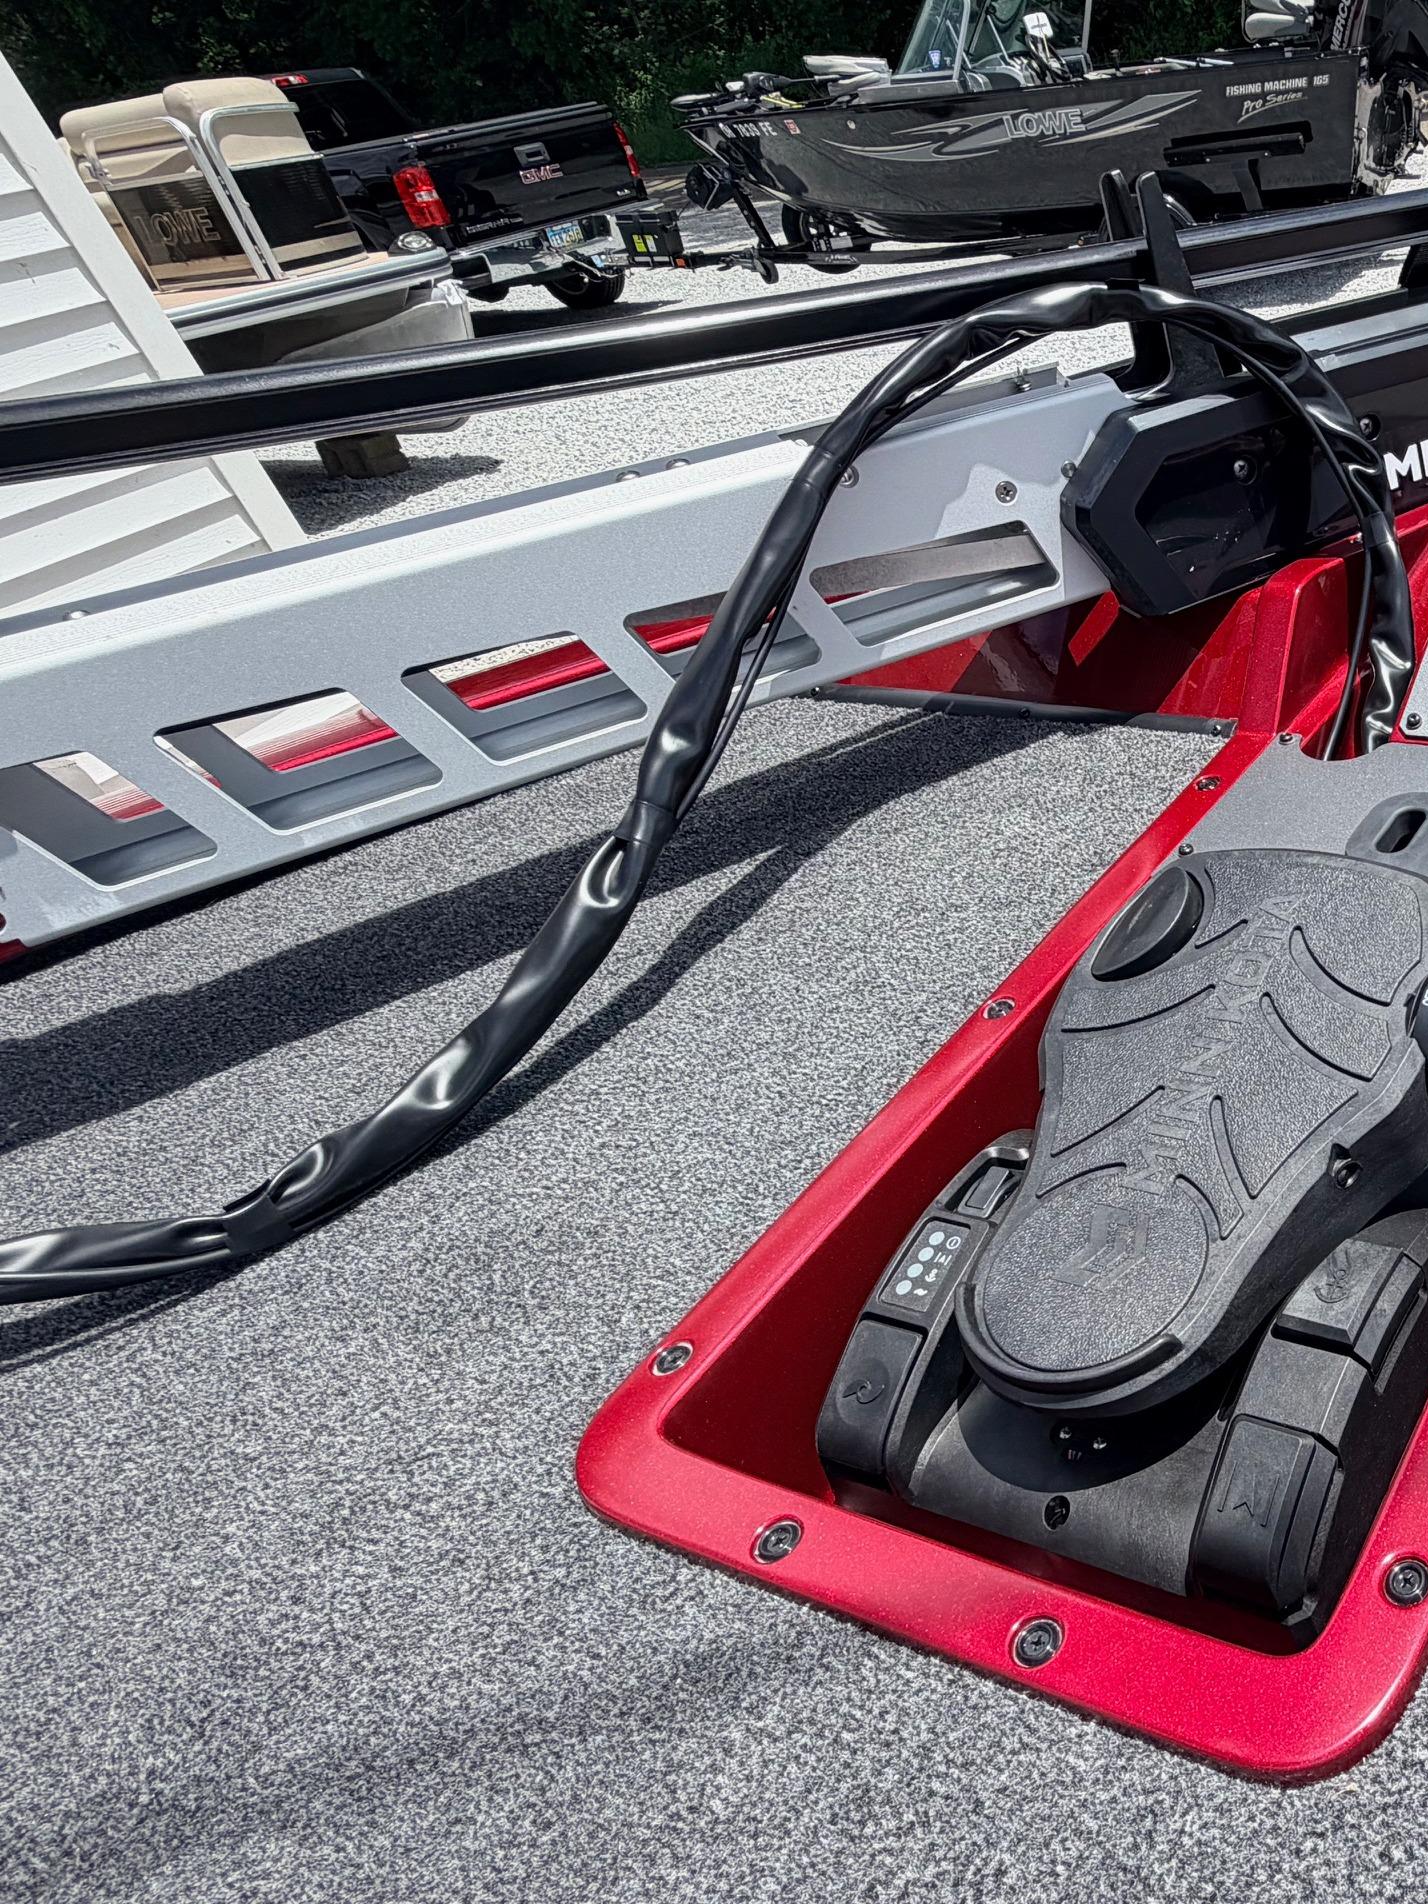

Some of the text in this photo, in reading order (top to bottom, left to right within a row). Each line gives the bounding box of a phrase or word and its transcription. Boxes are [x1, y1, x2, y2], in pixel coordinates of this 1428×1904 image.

[1226, 83, 1262, 97] FISHING
[1264, 77, 1308, 92] MACHINE
[1242, 92, 1304, 116] Pro Series
[1002, 108, 1087, 139] LOWE
[519, 163, 564, 185] GMC
[133, 206, 221, 247] LOWE
[1119, 896, 1302, 1196] MINN KOTA
